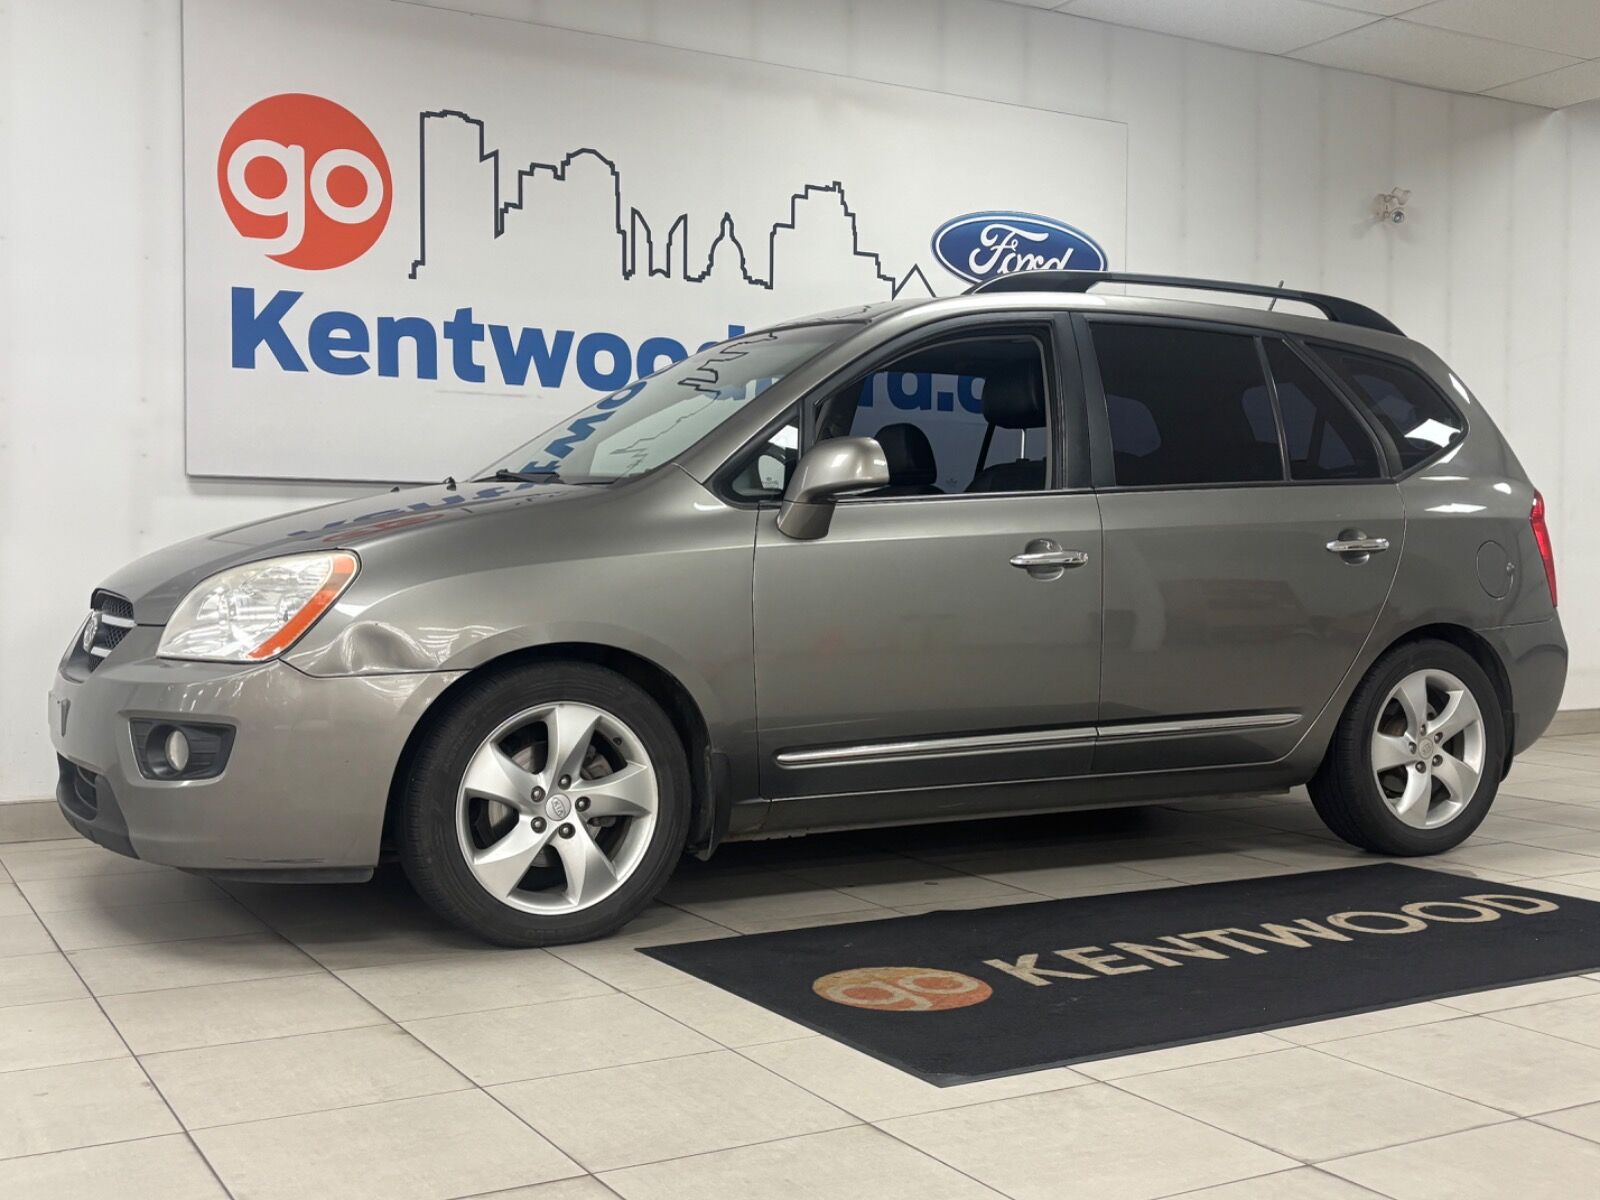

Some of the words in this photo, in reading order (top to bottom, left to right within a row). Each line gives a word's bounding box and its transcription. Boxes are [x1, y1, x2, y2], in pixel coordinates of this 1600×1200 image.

[226, 138, 385, 256] go
[968, 223, 1075, 274] Ford
[825, 973, 979, 1012] go
[983, 894, 1560, 987] KENTWOOD
